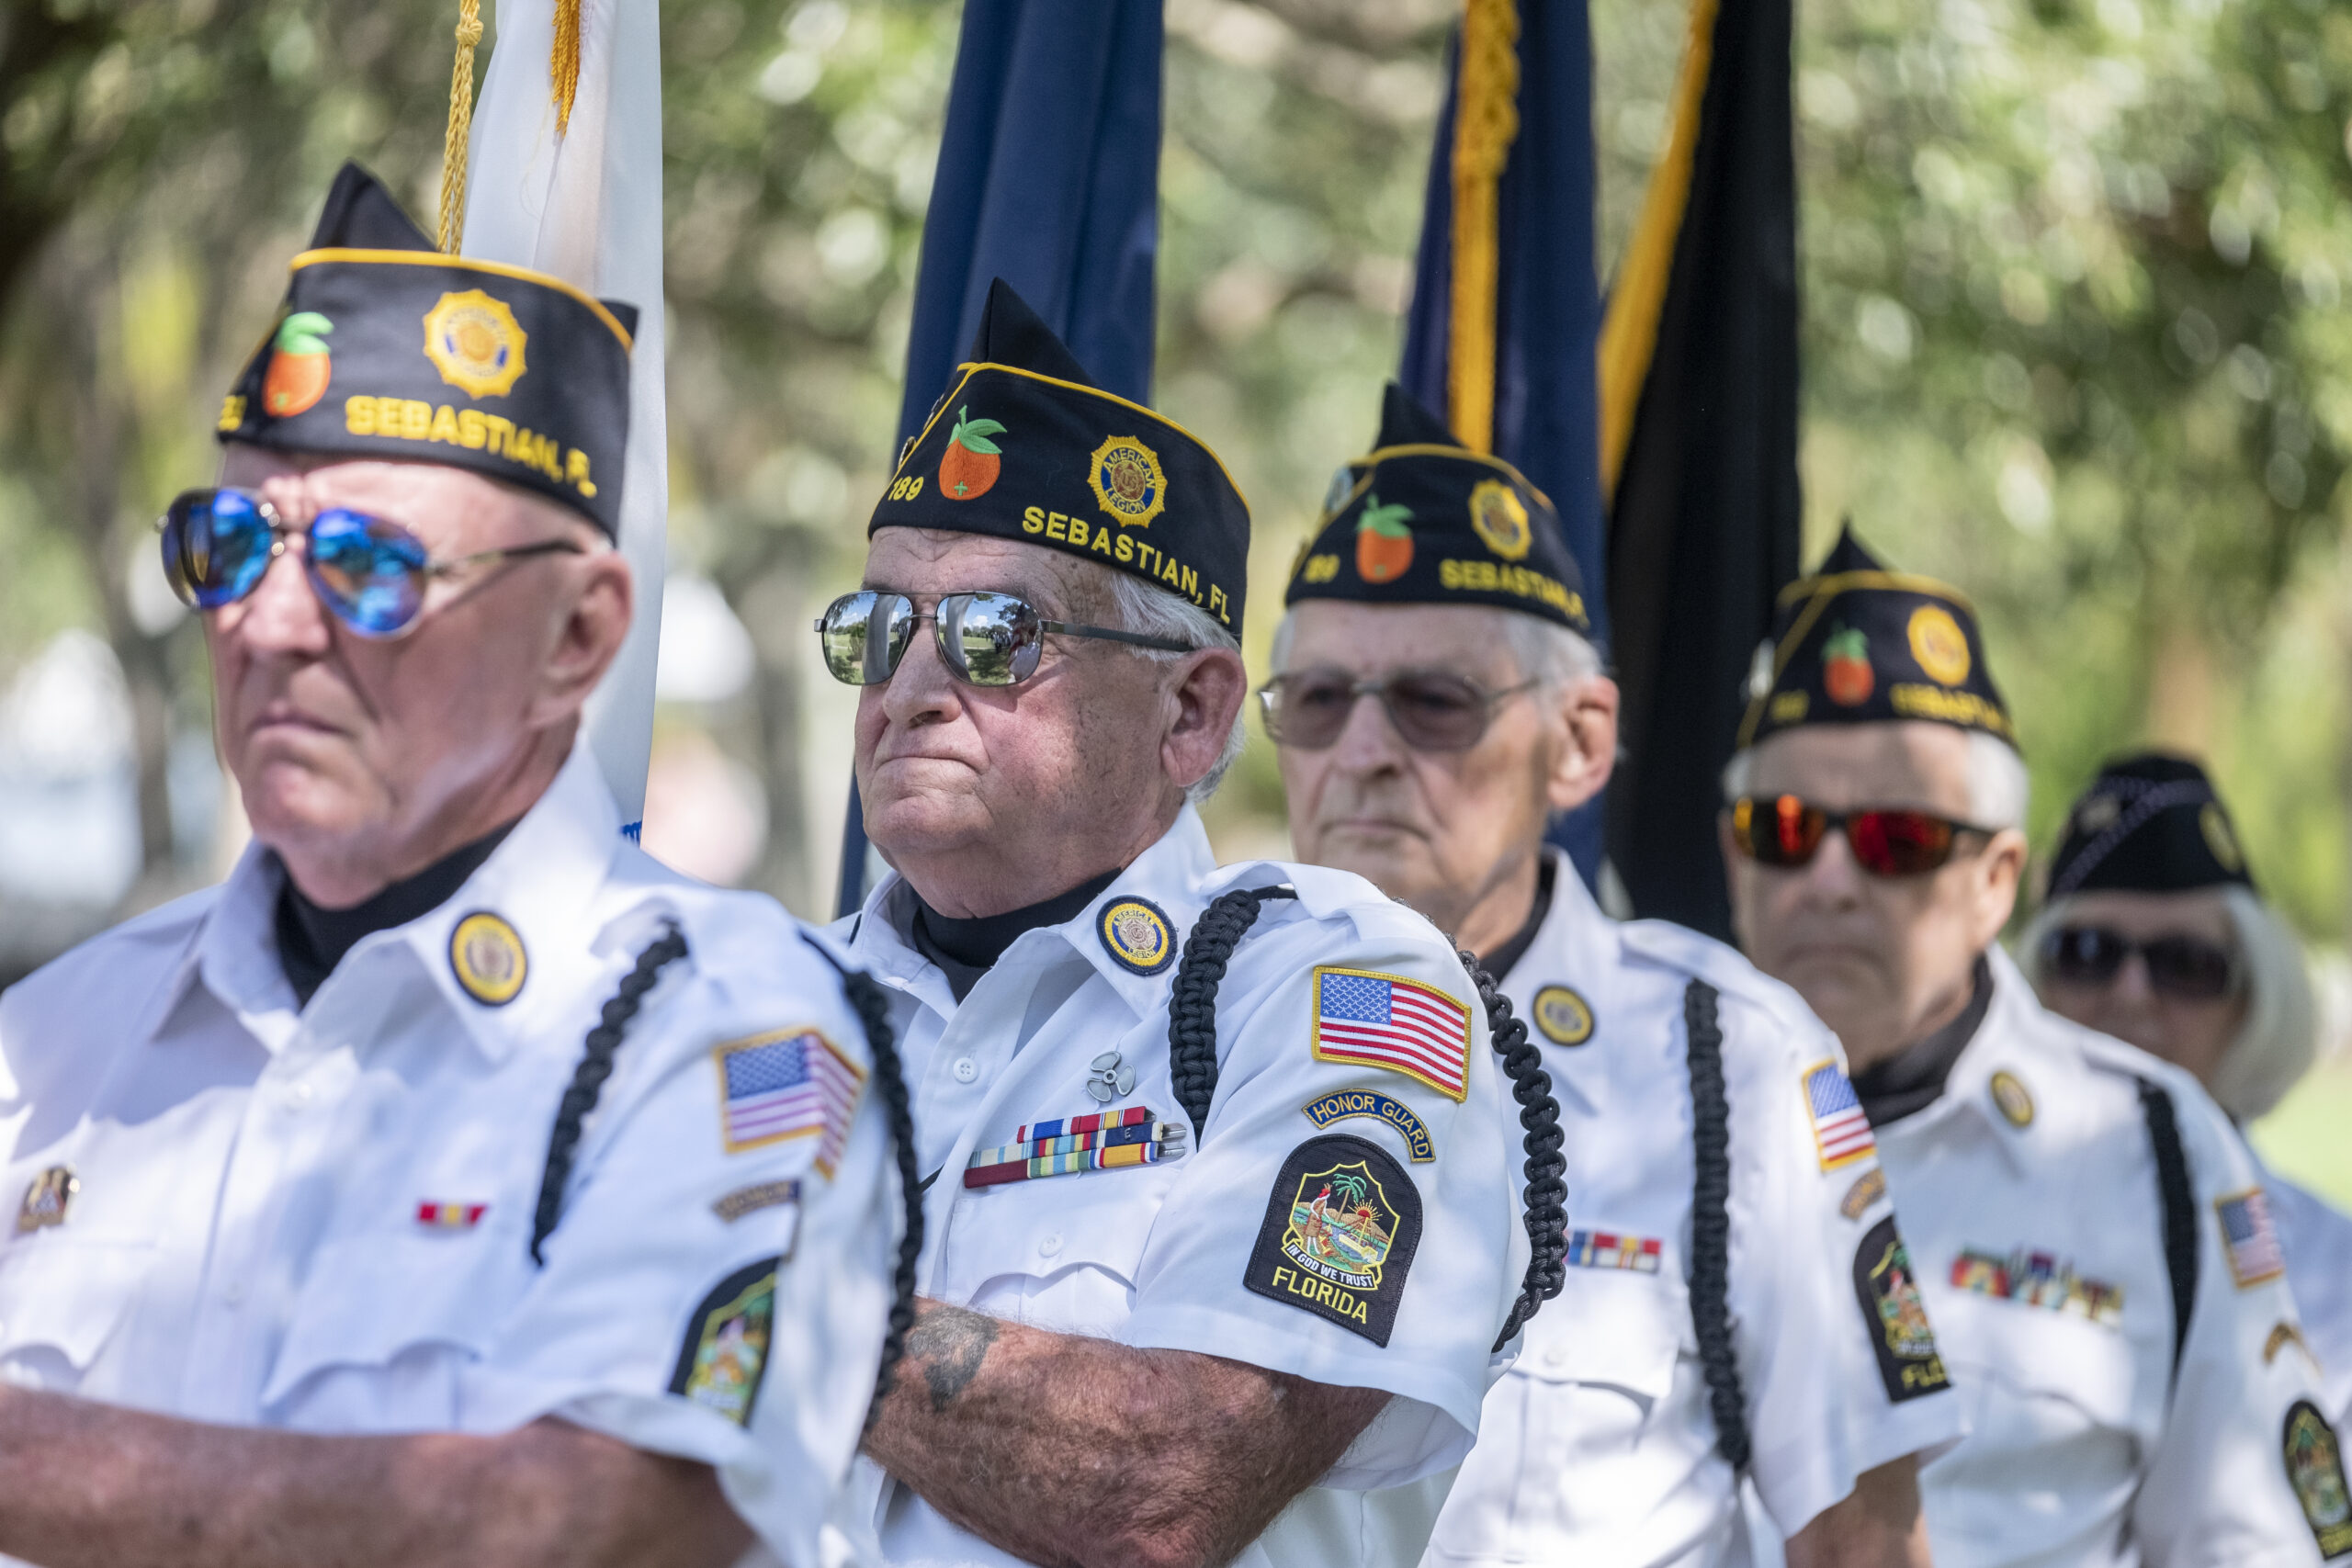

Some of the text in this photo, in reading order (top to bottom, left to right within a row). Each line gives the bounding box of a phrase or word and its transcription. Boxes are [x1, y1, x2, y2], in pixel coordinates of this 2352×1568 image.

[888, 476, 924, 502] 189
[1103, 448, 1156, 489] AMERICAN
[1105, 487, 1147, 514] LEGION
[1023, 506, 1231, 625] SEBASTIAN, FL
[1313, 1094, 1430, 1156] HONOR GUARD
[1286, 1244, 1374, 1287] IN GOD WE TRUST
[1272, 1266, 1368, 1325] FLORIDA
